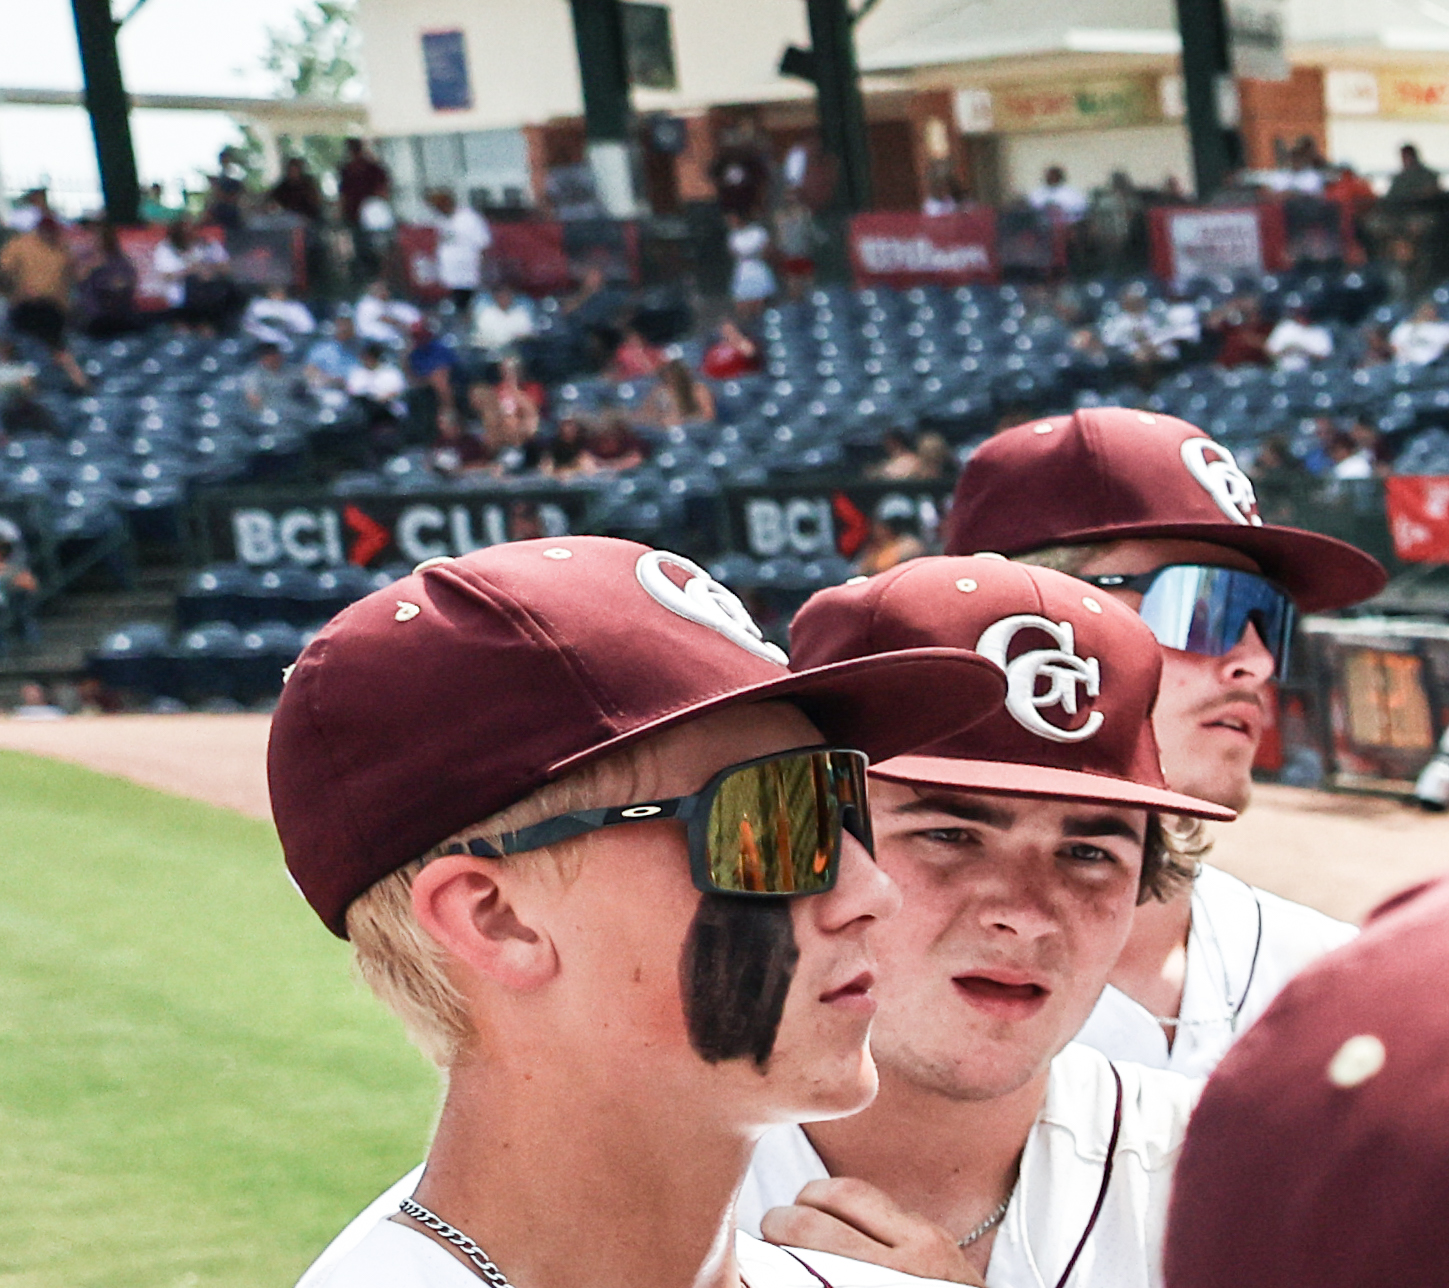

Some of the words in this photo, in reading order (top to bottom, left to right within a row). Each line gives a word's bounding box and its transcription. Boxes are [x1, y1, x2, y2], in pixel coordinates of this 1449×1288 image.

[233, 505, 345, 566] BCI
[396, 502, 570, 558] CL
[744, 497, 833, 556] BCI
